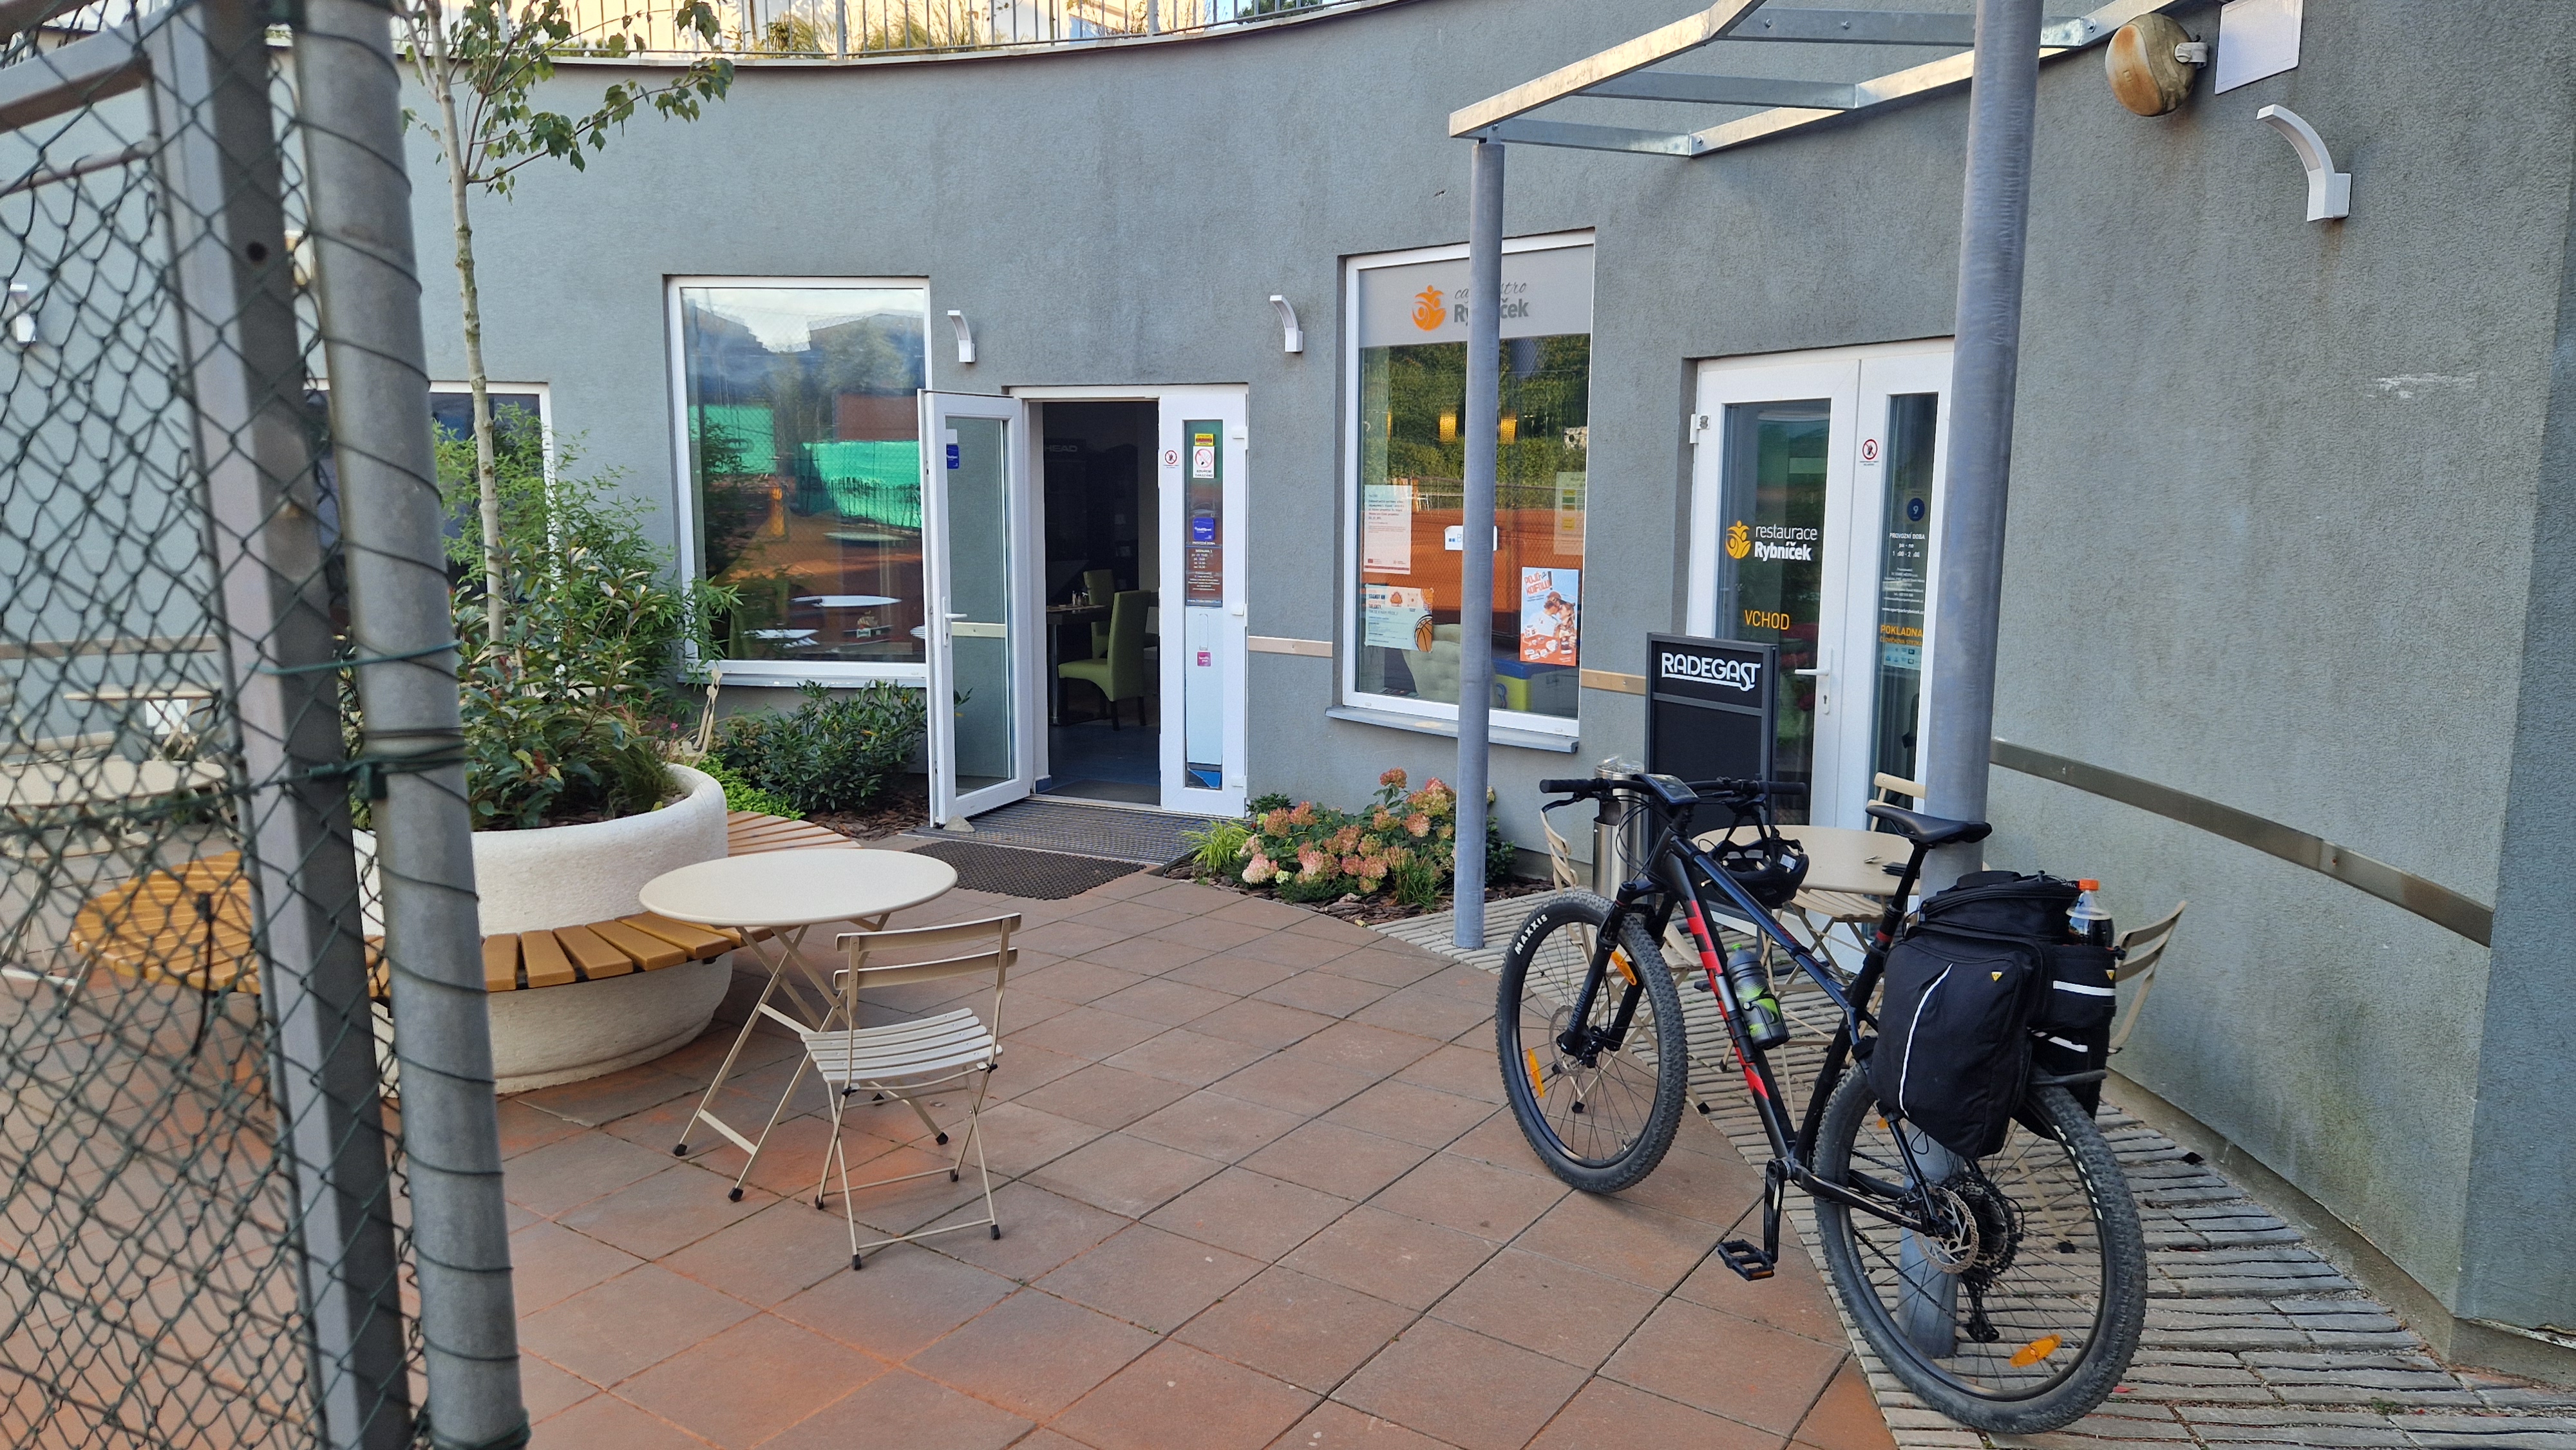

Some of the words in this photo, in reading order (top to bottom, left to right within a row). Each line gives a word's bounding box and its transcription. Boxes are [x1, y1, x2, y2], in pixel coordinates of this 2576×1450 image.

[1913, 505, 1919, 514] 9
[1755, 523, 1817, 541] restaurace
[1754, 541, 1812, 561] Rybníček
[1744, 609, 1790, 630] VCHOD
[1880, 625, 1923, 637] POKLADNA
[1661, 652, 1761, 692] RADEGAST
[1514, 914, 1548, 956] MAXXIS
